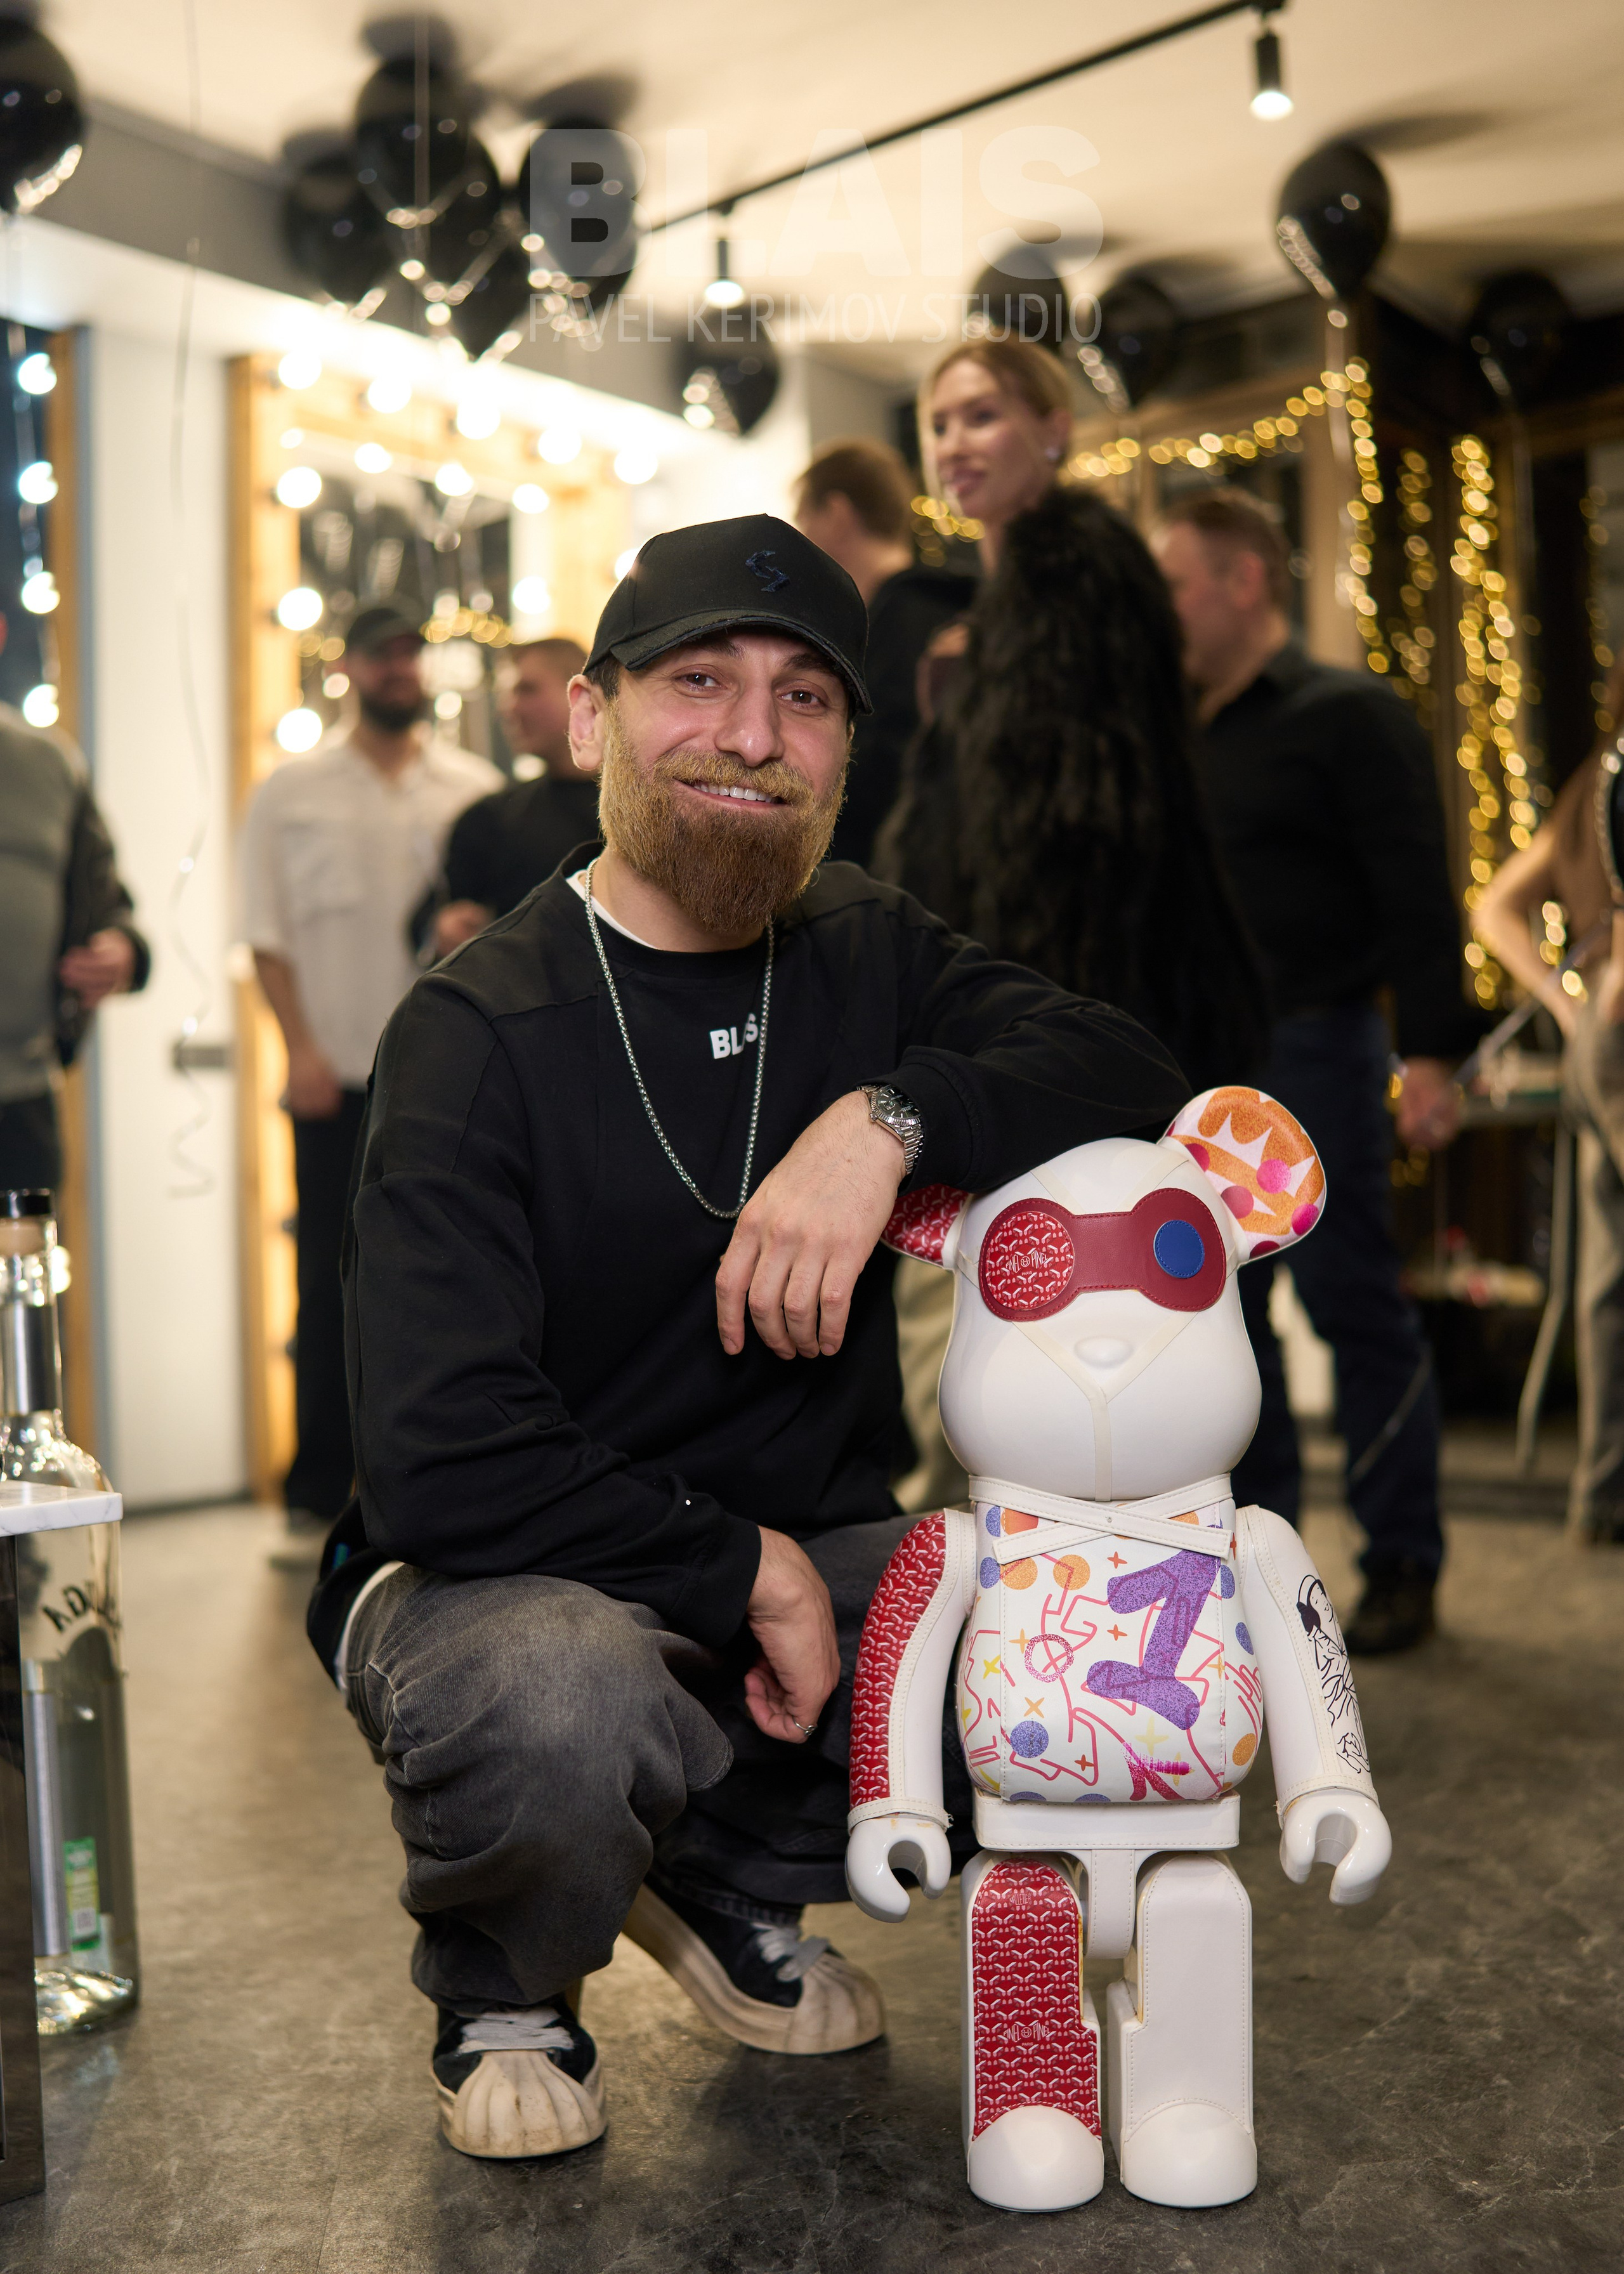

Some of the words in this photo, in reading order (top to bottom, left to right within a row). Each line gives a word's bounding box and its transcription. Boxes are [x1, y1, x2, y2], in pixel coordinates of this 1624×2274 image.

[1005, 1255, 1021, 1273] PINEL
[1031, 1250, 1048, 1269] PINEL
[1003, 2023, 1021, 2043] PINEL
[1033, 2022, 1051, 2041] PINEL
